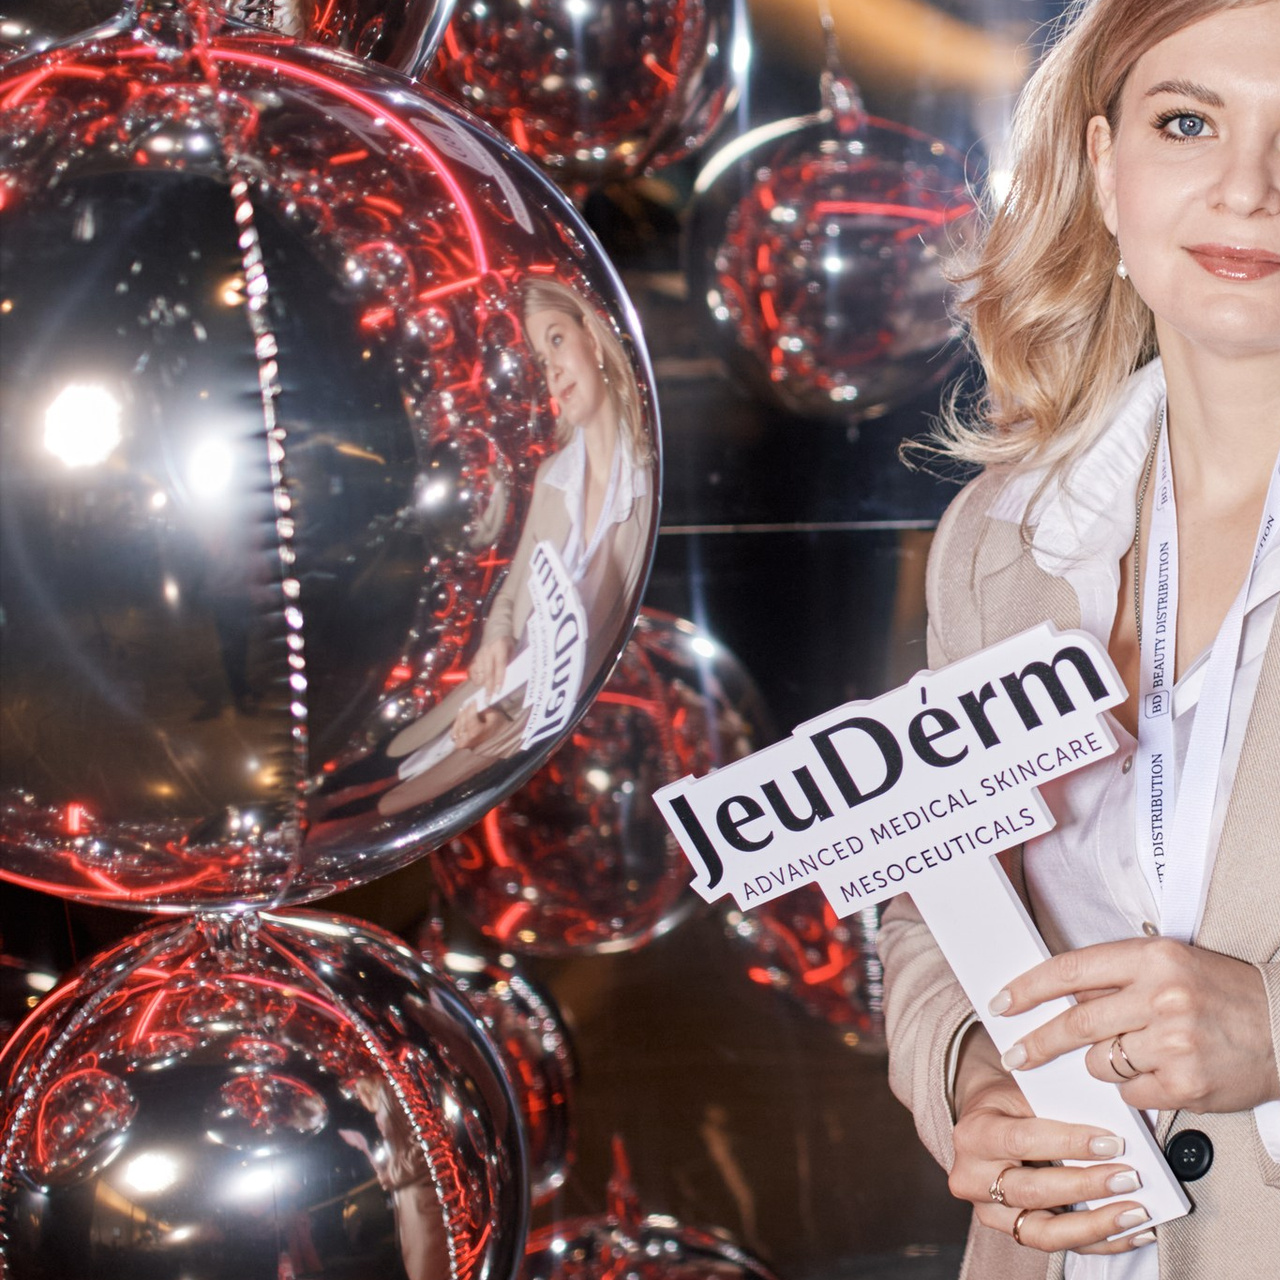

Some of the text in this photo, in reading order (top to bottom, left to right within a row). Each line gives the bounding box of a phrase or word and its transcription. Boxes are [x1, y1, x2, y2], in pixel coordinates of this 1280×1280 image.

[1151, 540, 1169, 715] BD BEAUTY DISTRIBUTION
[669, 645, 1110, 890] JeuDérm
[744, 732, 1103, 901] ADVANCED MEDICAL SKINCARE
[1151, 753, 1165, 857] DISTRIBUTION
[839, 807, 1036, 903] MESOCEUTICALS
